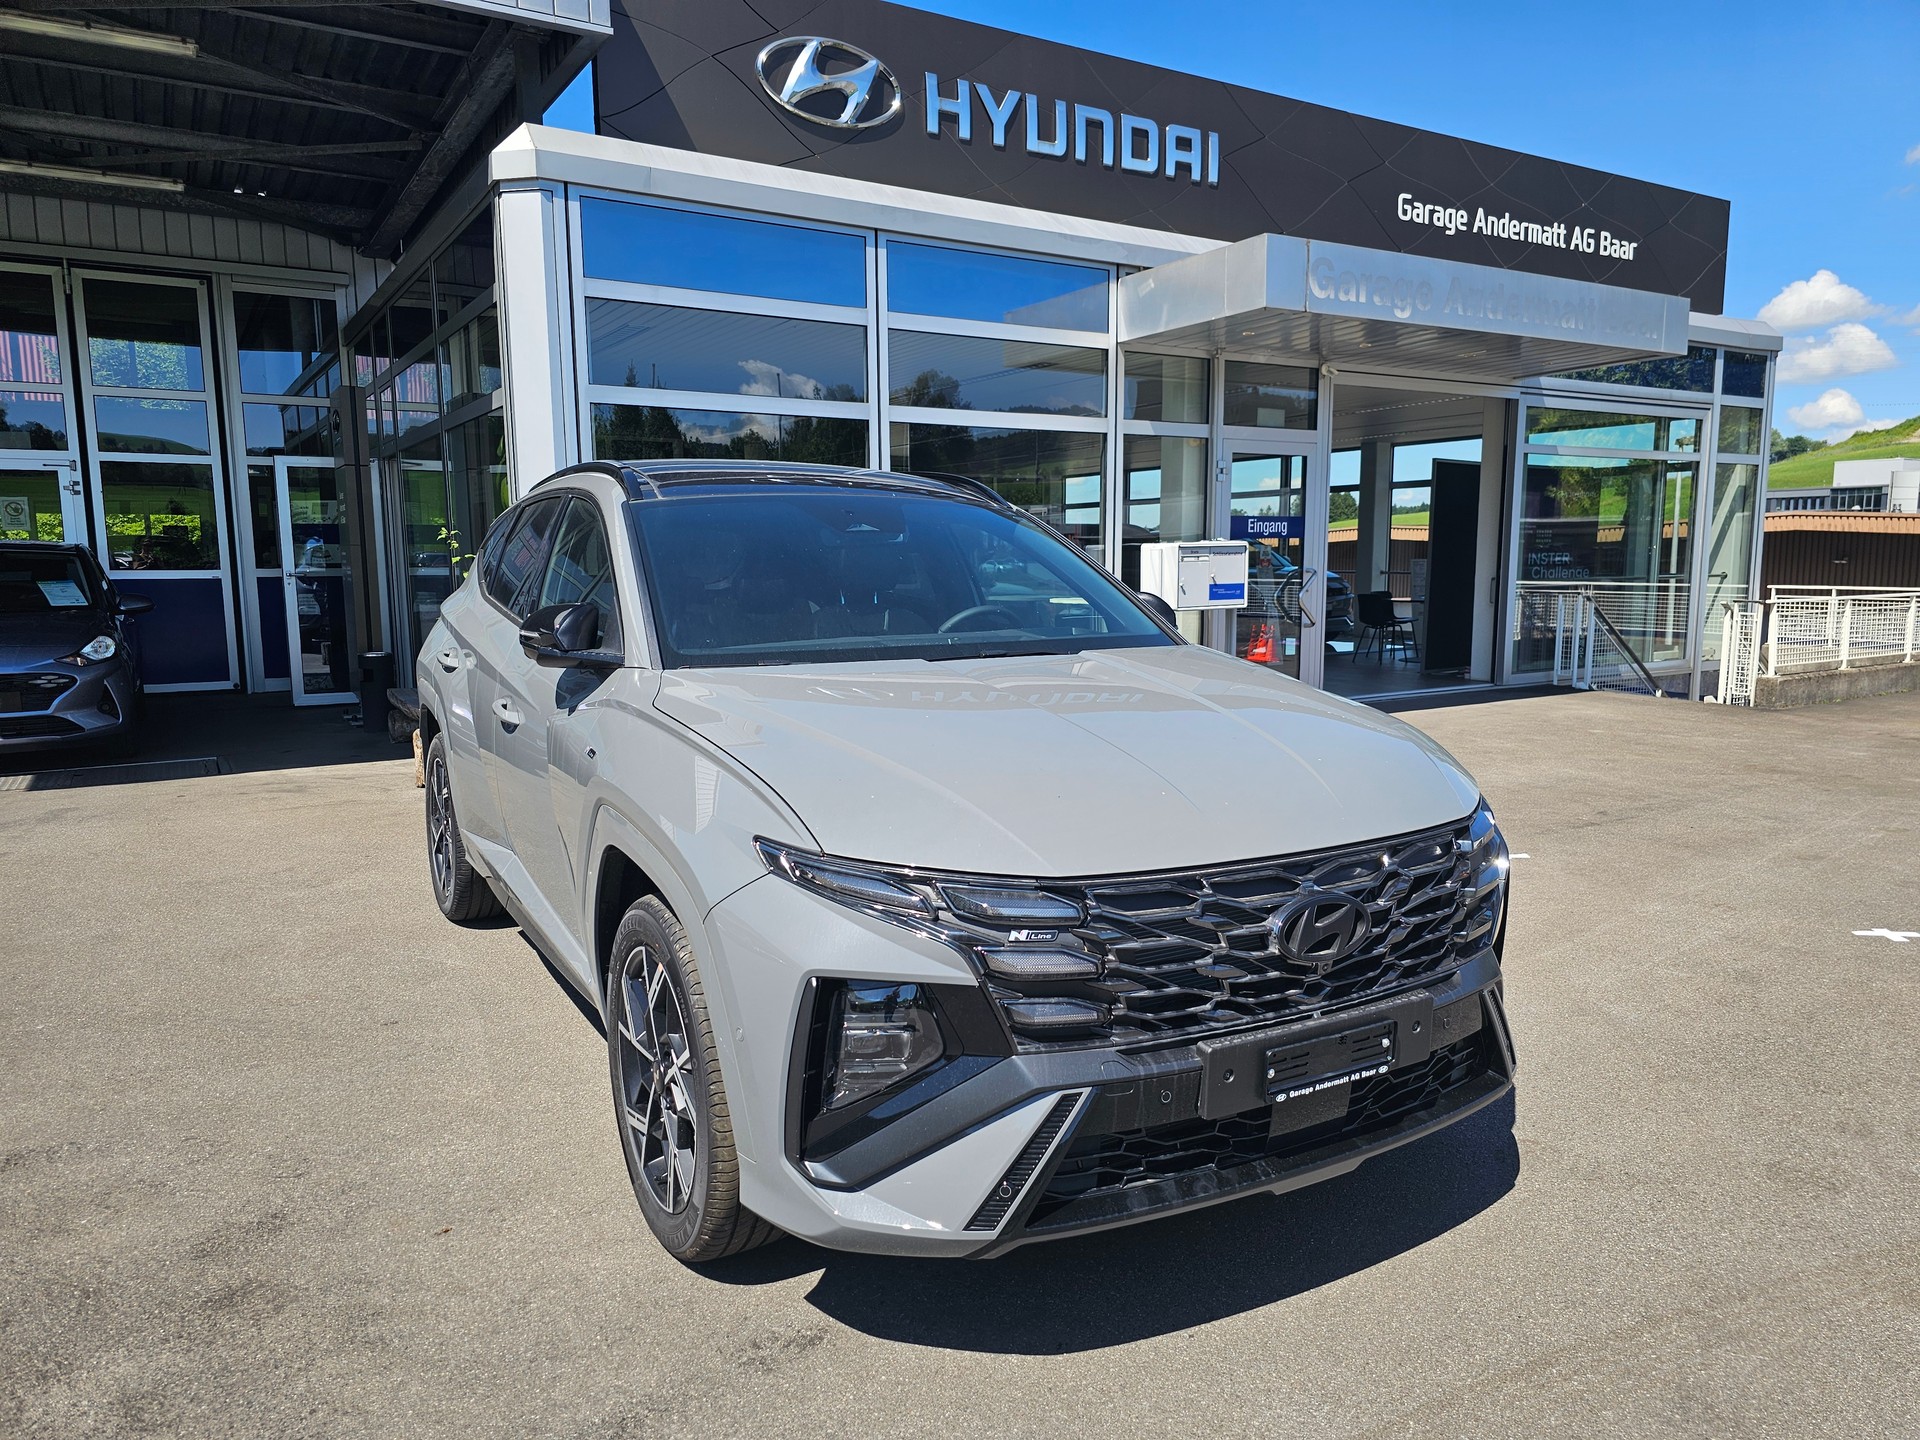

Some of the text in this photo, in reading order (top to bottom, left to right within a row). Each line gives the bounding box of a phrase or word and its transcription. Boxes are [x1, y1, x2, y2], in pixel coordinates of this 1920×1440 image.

[925, 71, 1220, 187] HYUNDAI
[1397, 193, 1638, 261] Garage Andermatt AG Baar
[1309, 256, 1432, 319] Garage
[1247, 518, 1288, 536] Eingang
[1528, 552, 1572, 565] INSTER
[1289, 1087, 1314, 1098] Garage
[1315, 1076, 1349, 1091] Andermatt
[1350, 1072, 1360, 1081] AG
